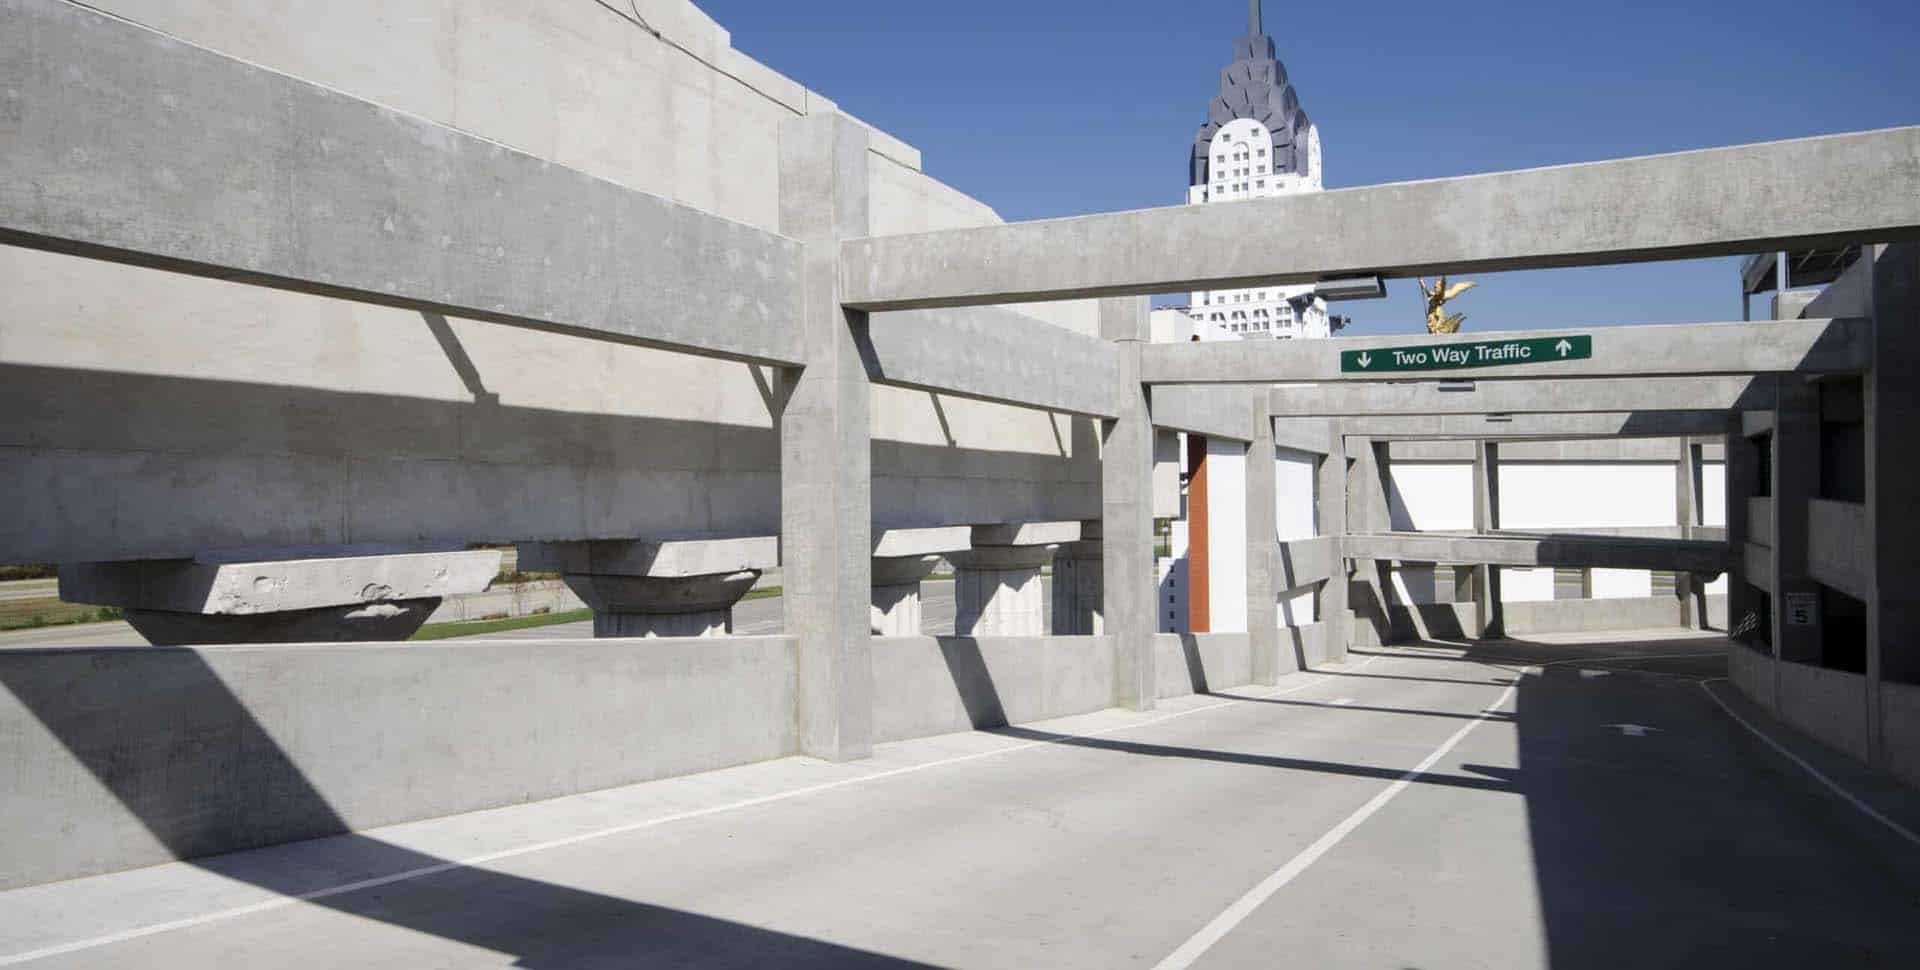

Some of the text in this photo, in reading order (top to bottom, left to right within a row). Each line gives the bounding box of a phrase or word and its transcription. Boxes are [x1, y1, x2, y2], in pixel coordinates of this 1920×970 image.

[1393, 344, 1531, 365] Two Way Traffic
[1795, 610, 1808, 623] 5
